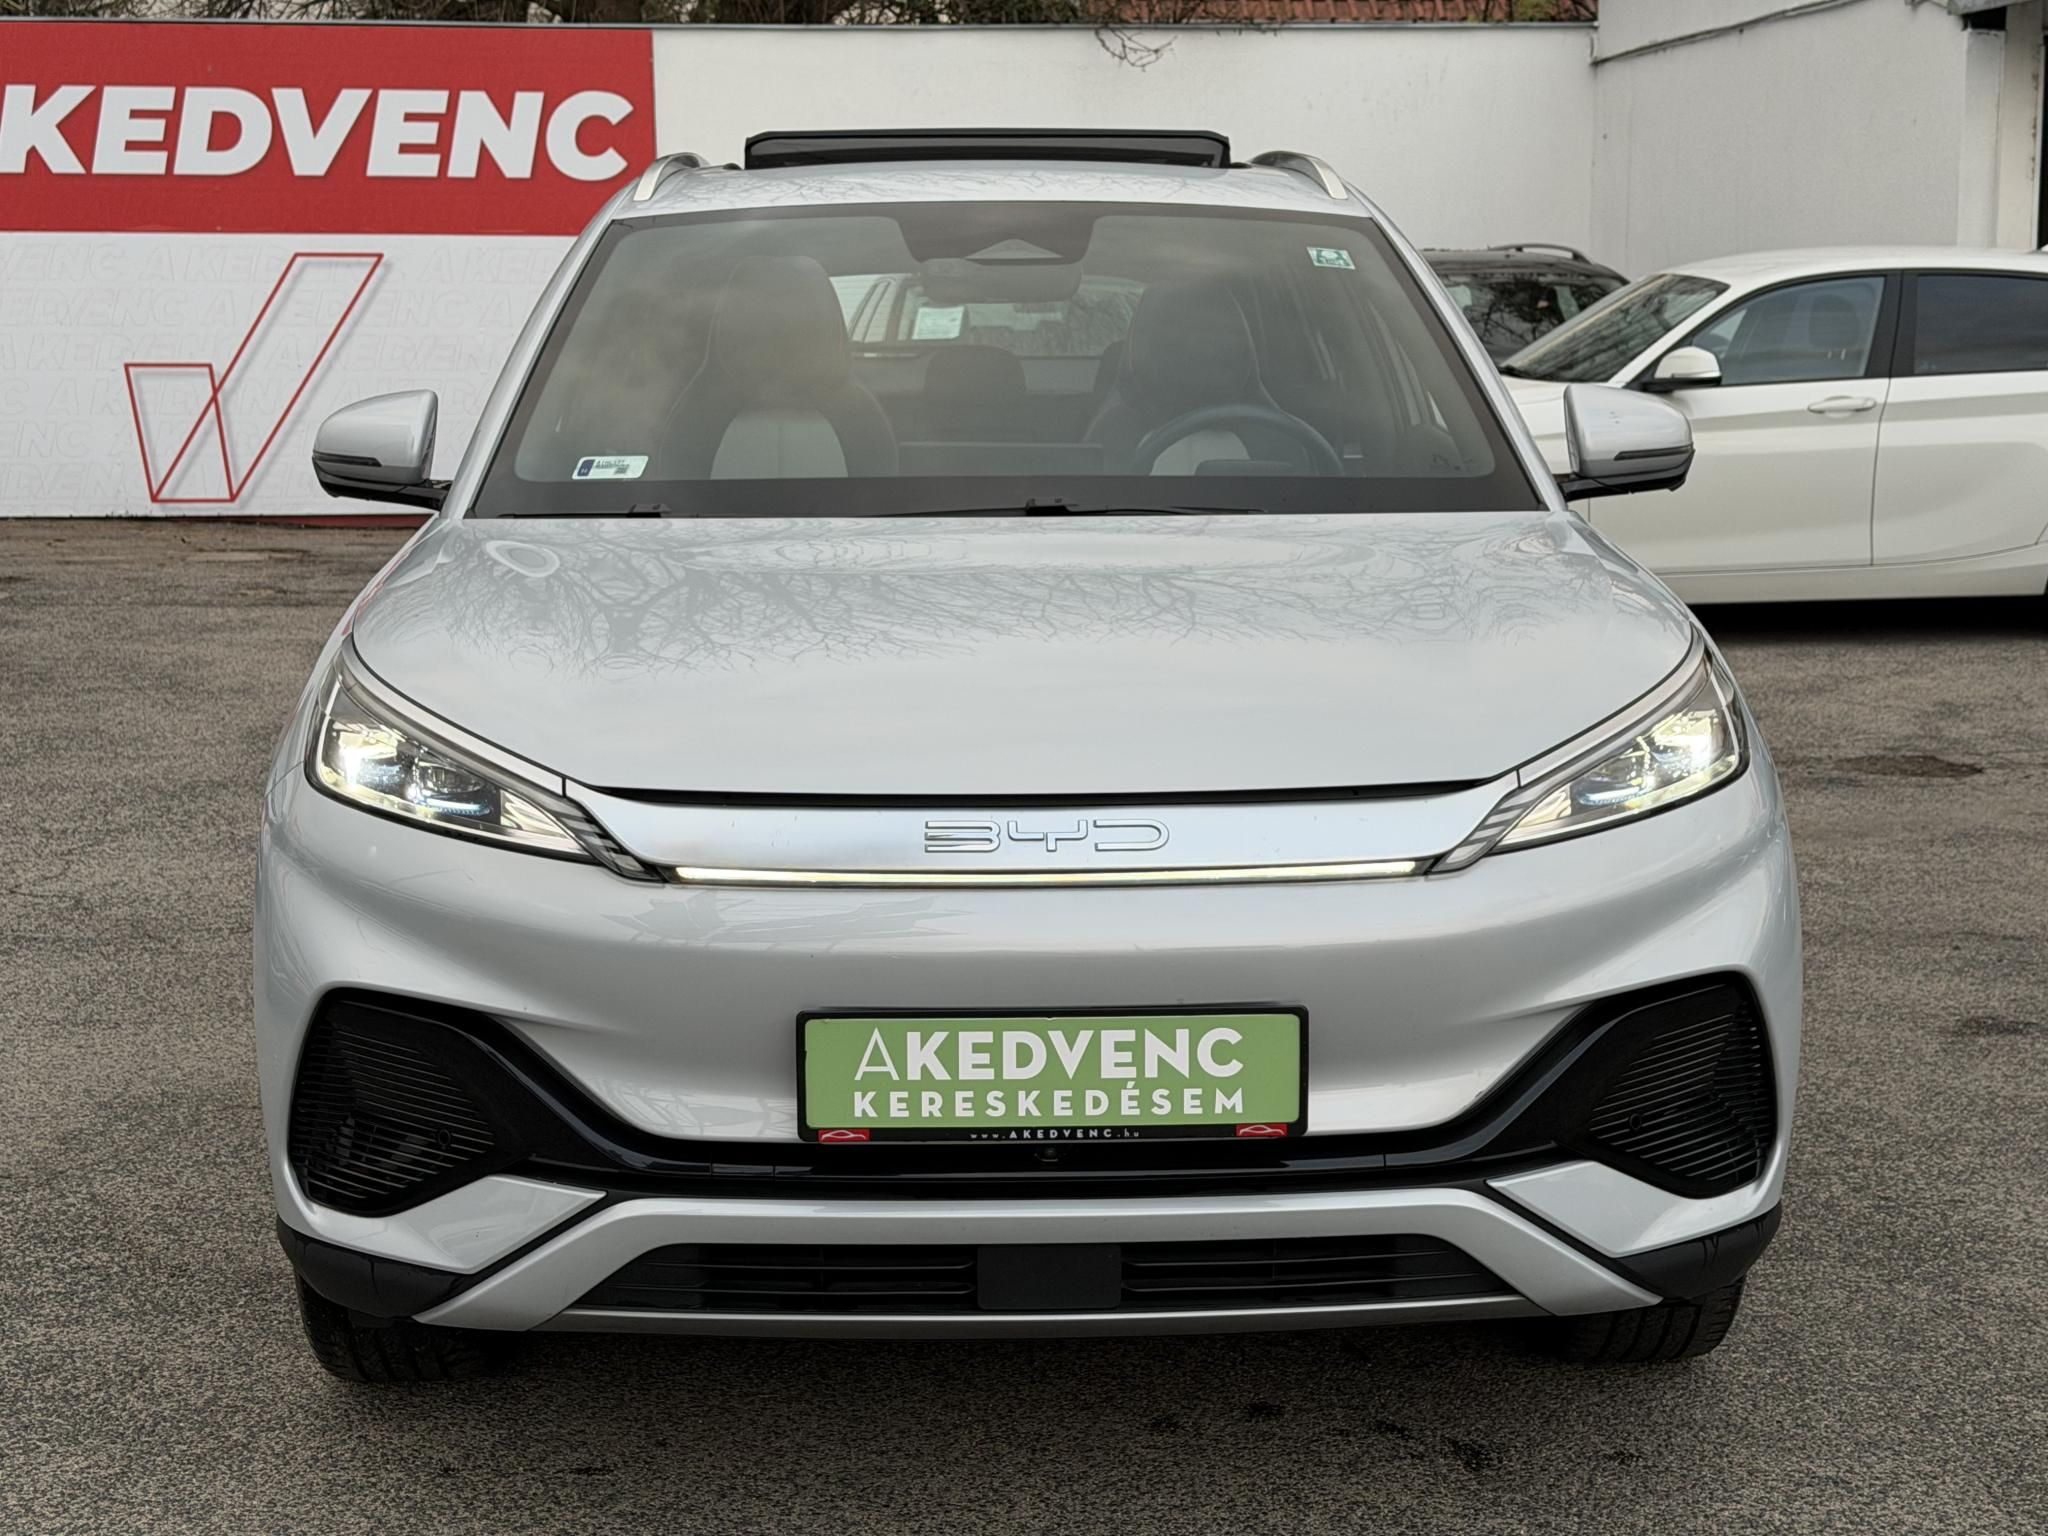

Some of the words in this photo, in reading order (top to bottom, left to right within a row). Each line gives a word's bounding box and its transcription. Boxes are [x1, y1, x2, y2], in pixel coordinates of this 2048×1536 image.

[0, 84, 634, 181] KEDVENC
[924, 818, 1170, 853] BYD
[854, 1026, 1244, 1081] AKEDVENC
[854, 1081, 1244, 1118] KERESKEDÉSEM
[970, 1128, 1140, 1139] www.AKEDVENC.hu
